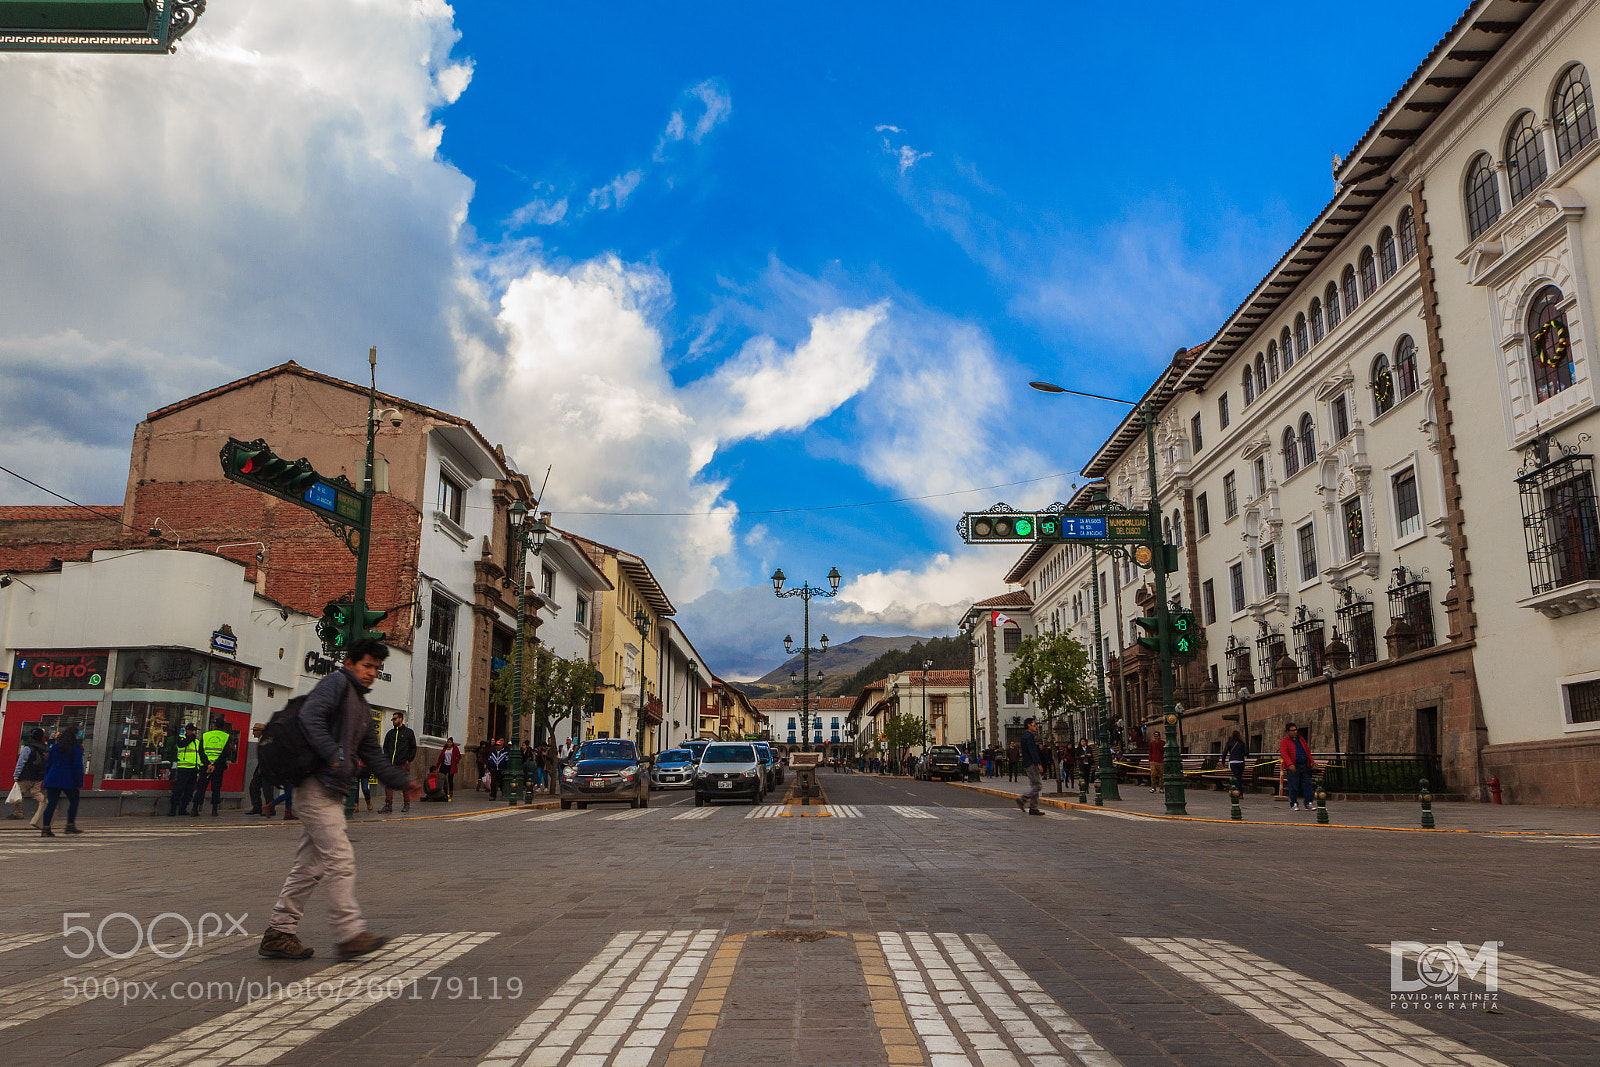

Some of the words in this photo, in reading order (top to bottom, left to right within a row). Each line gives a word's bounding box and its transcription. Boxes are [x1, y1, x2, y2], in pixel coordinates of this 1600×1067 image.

[1041, 522, 1055, 534] 49
[1109, 519, 1147, 527] MUNICIPALIDAD
[1116, 527, 1125, 535] DEL
[1126, 527, 1141, 535] CUSCO
[33, 661, 88, 677] Claro
[219, 671, 244, 690] Claro
